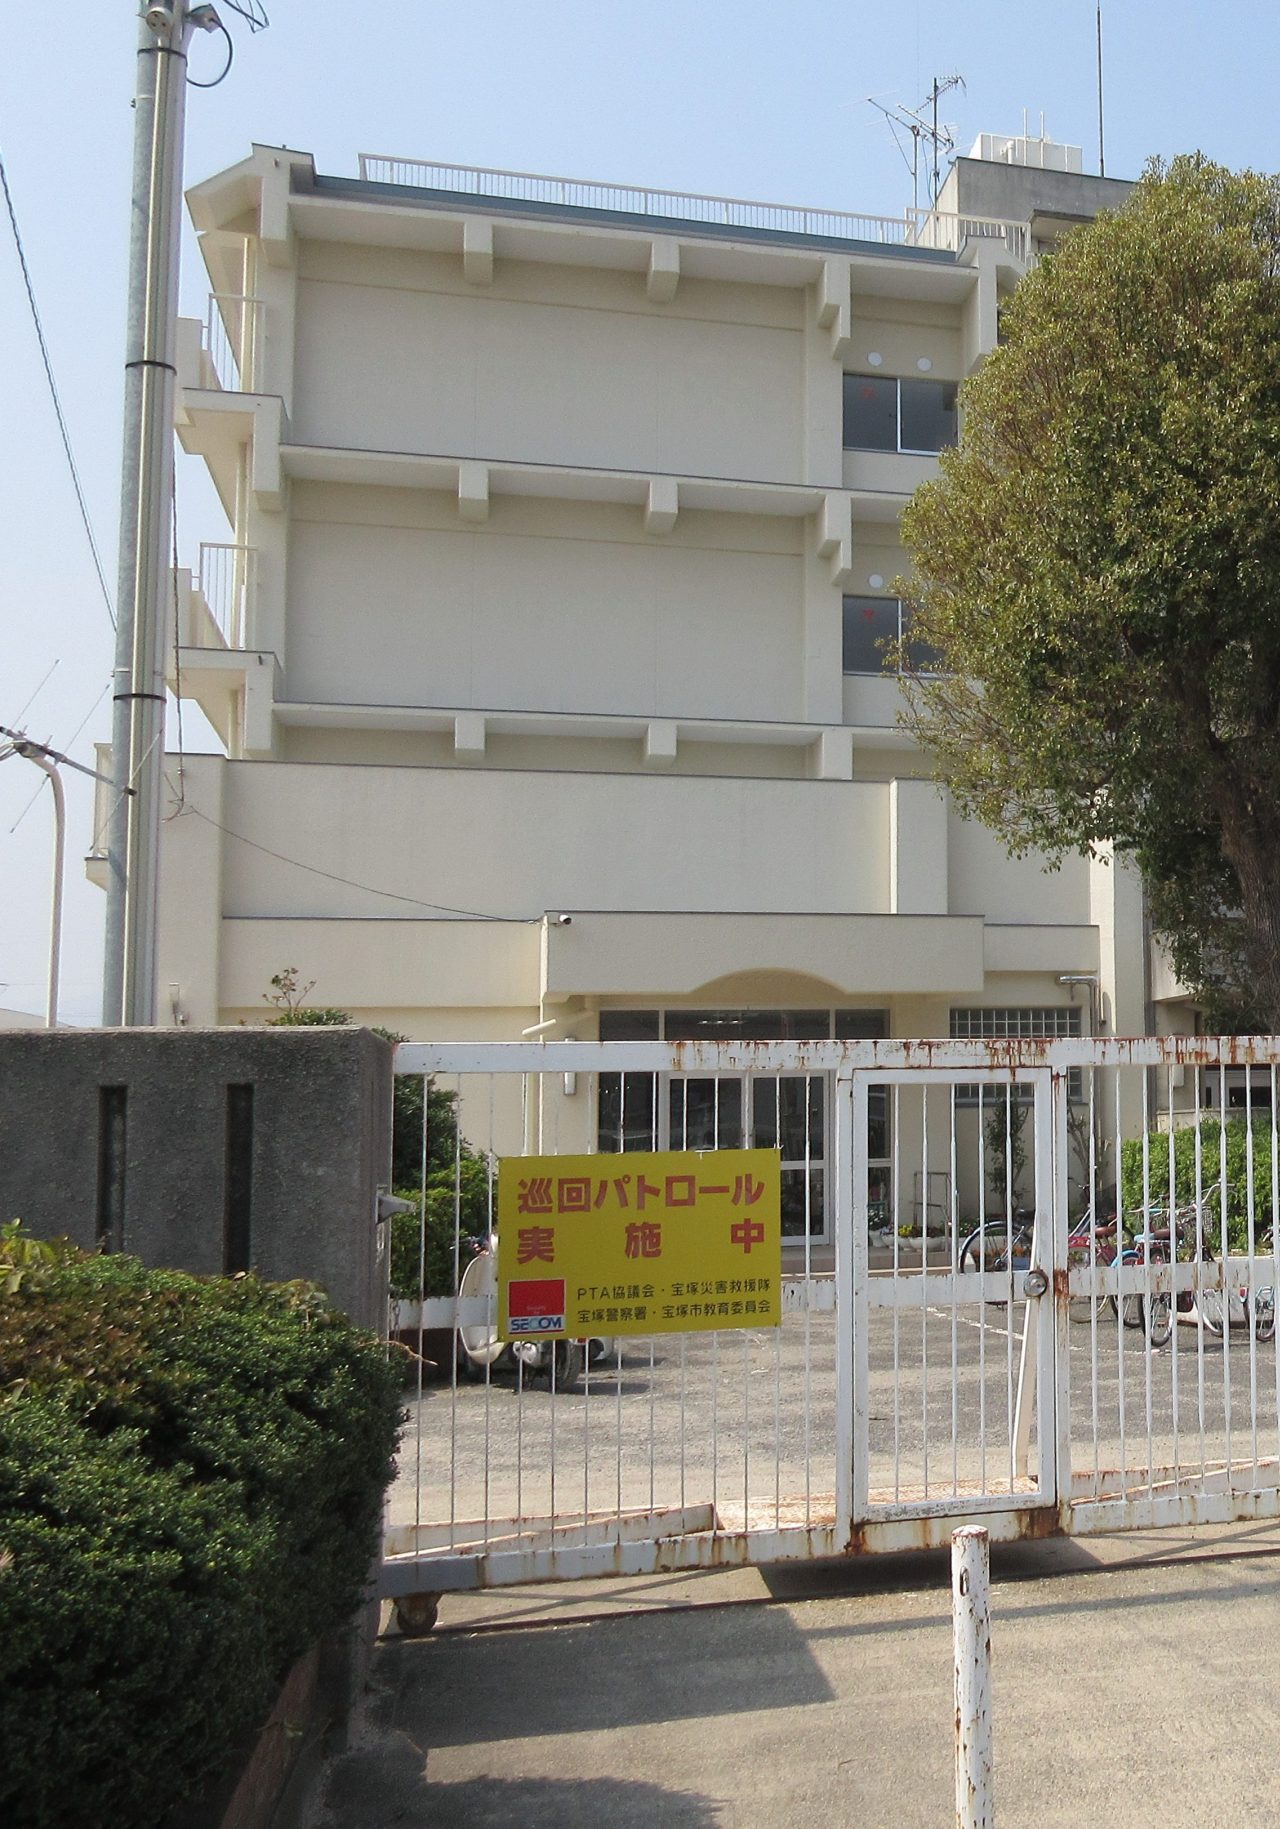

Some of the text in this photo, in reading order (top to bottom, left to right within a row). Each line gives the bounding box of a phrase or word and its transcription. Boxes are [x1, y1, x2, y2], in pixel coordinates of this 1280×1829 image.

[517, 1173, 765, 1214] 巡回パトロール
[510, 1317, 562, 1331] SECOM
